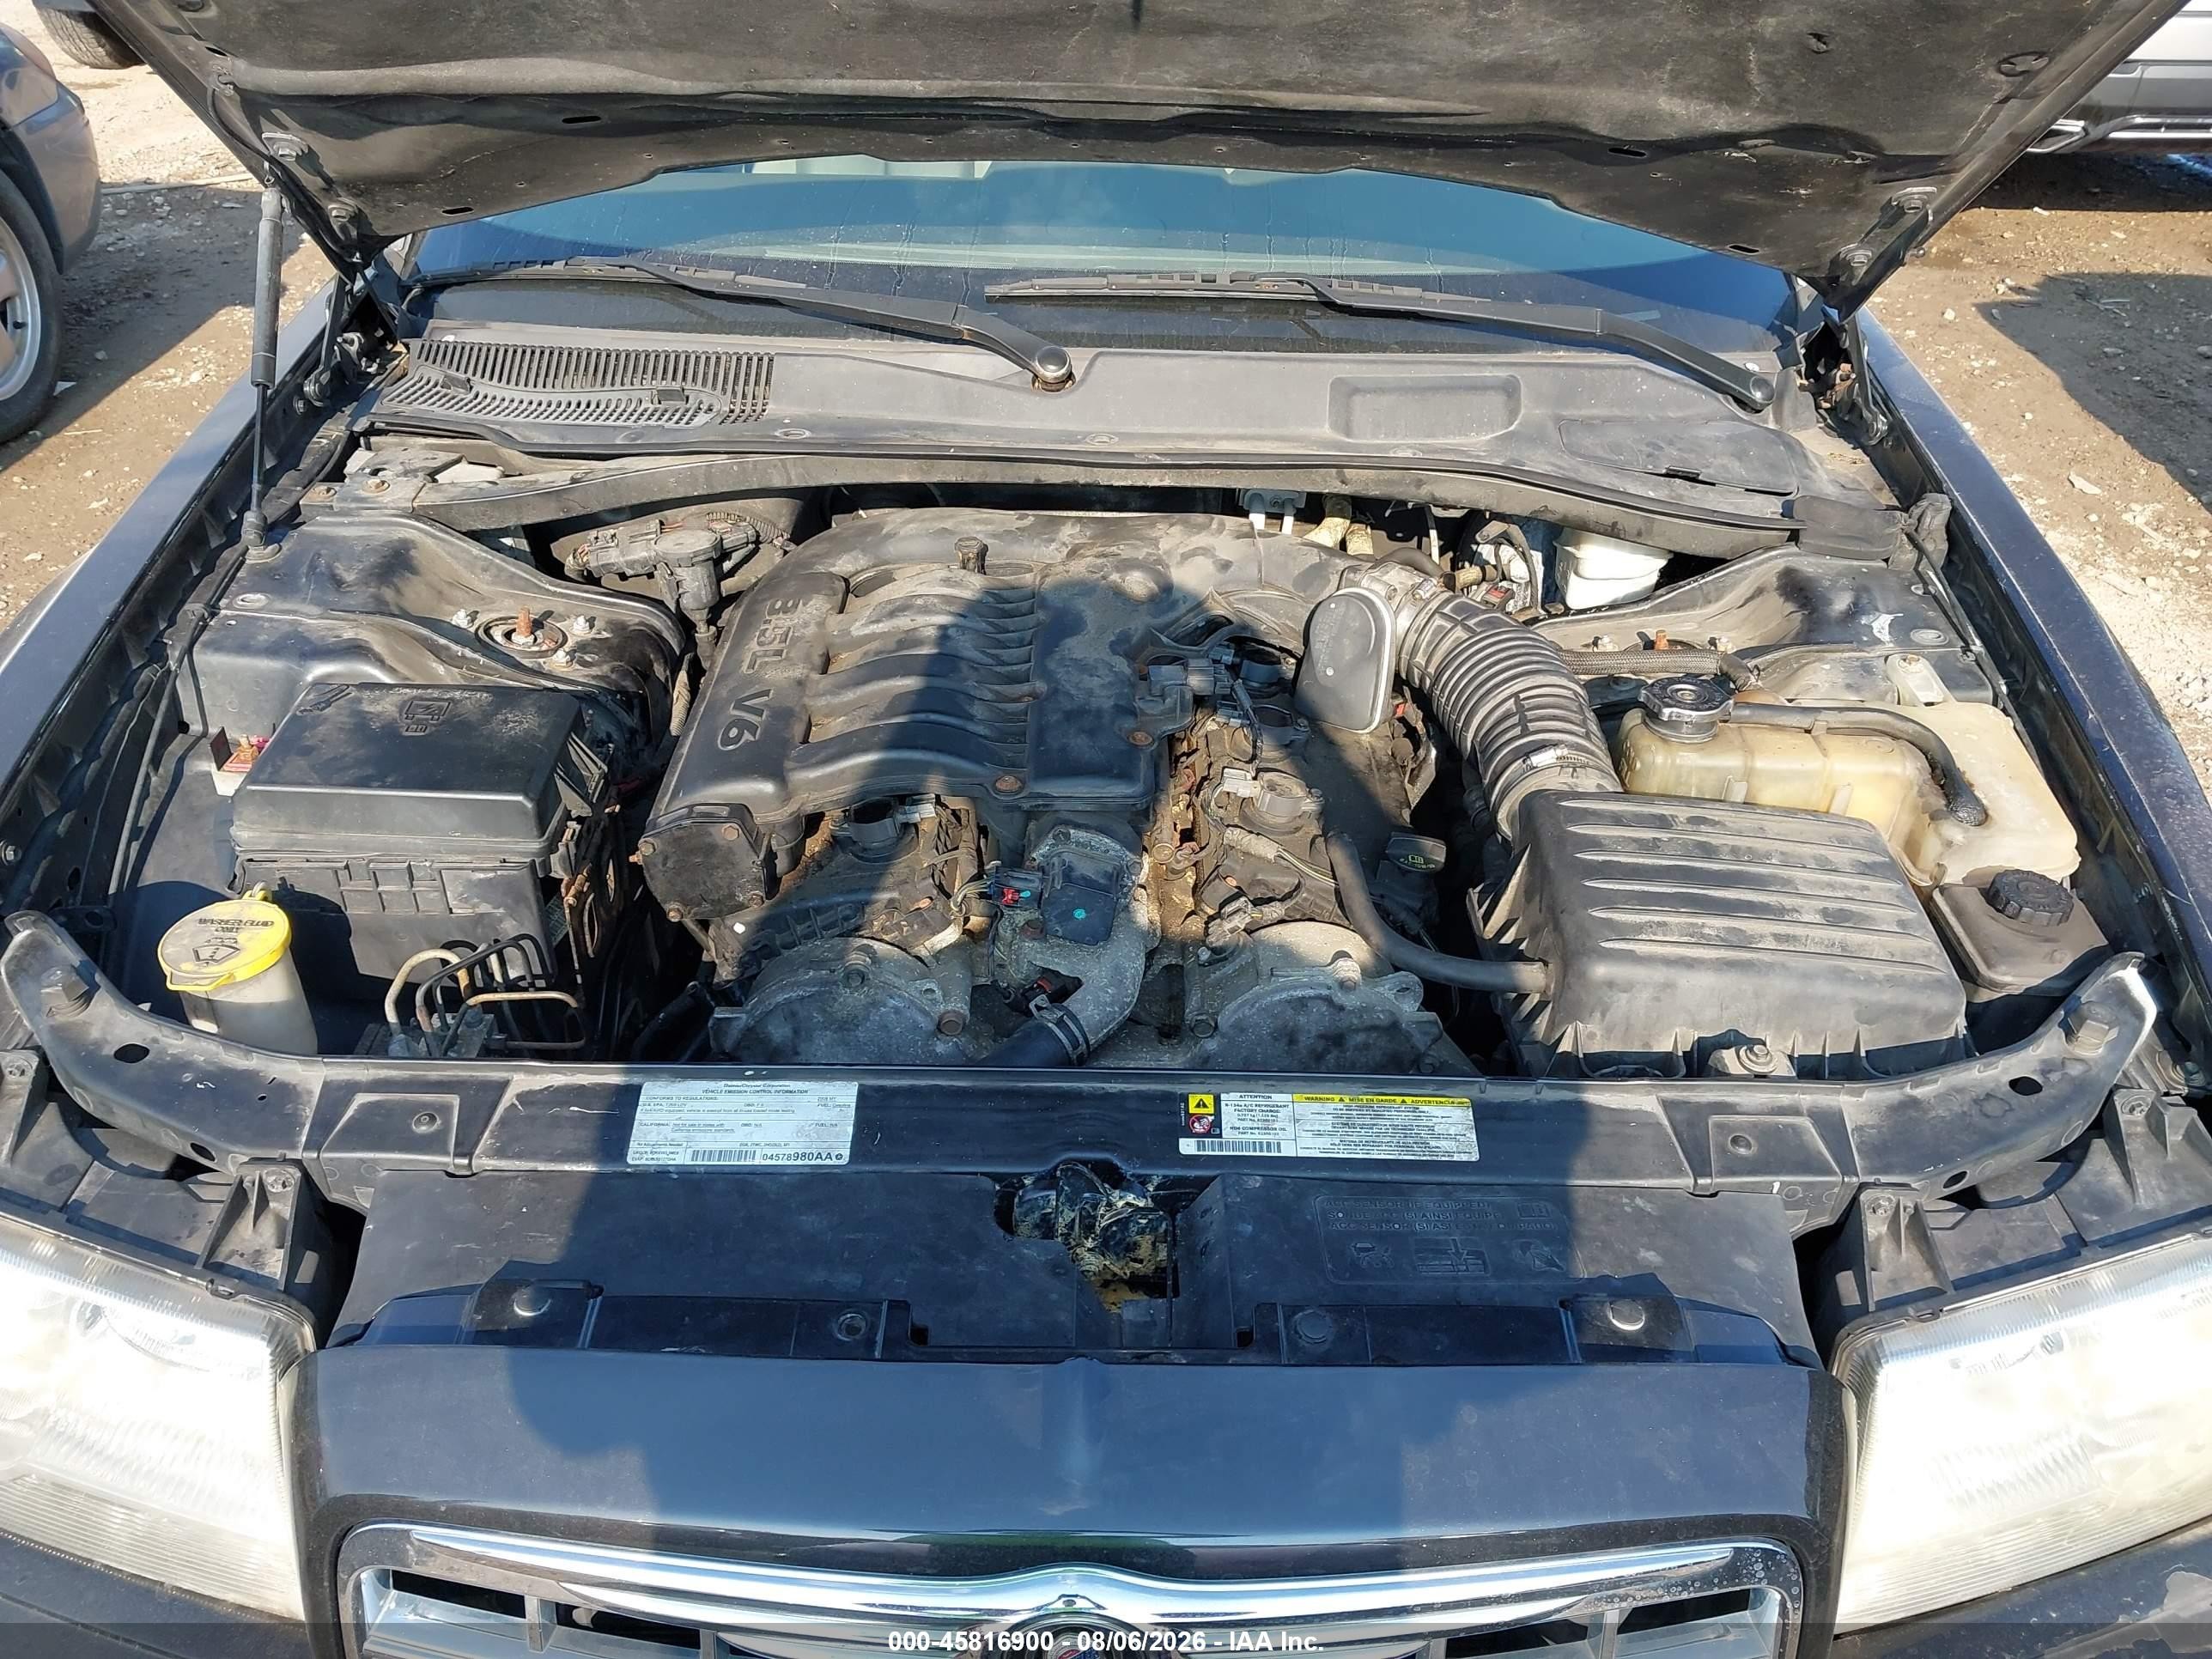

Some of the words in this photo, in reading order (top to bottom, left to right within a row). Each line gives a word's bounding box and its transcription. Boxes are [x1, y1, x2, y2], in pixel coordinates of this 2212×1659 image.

[717, 688, 773, 750] V6
[245, 918, 274, 927] FLUID
[763, 1152, 833, 1161] 04578980AA
